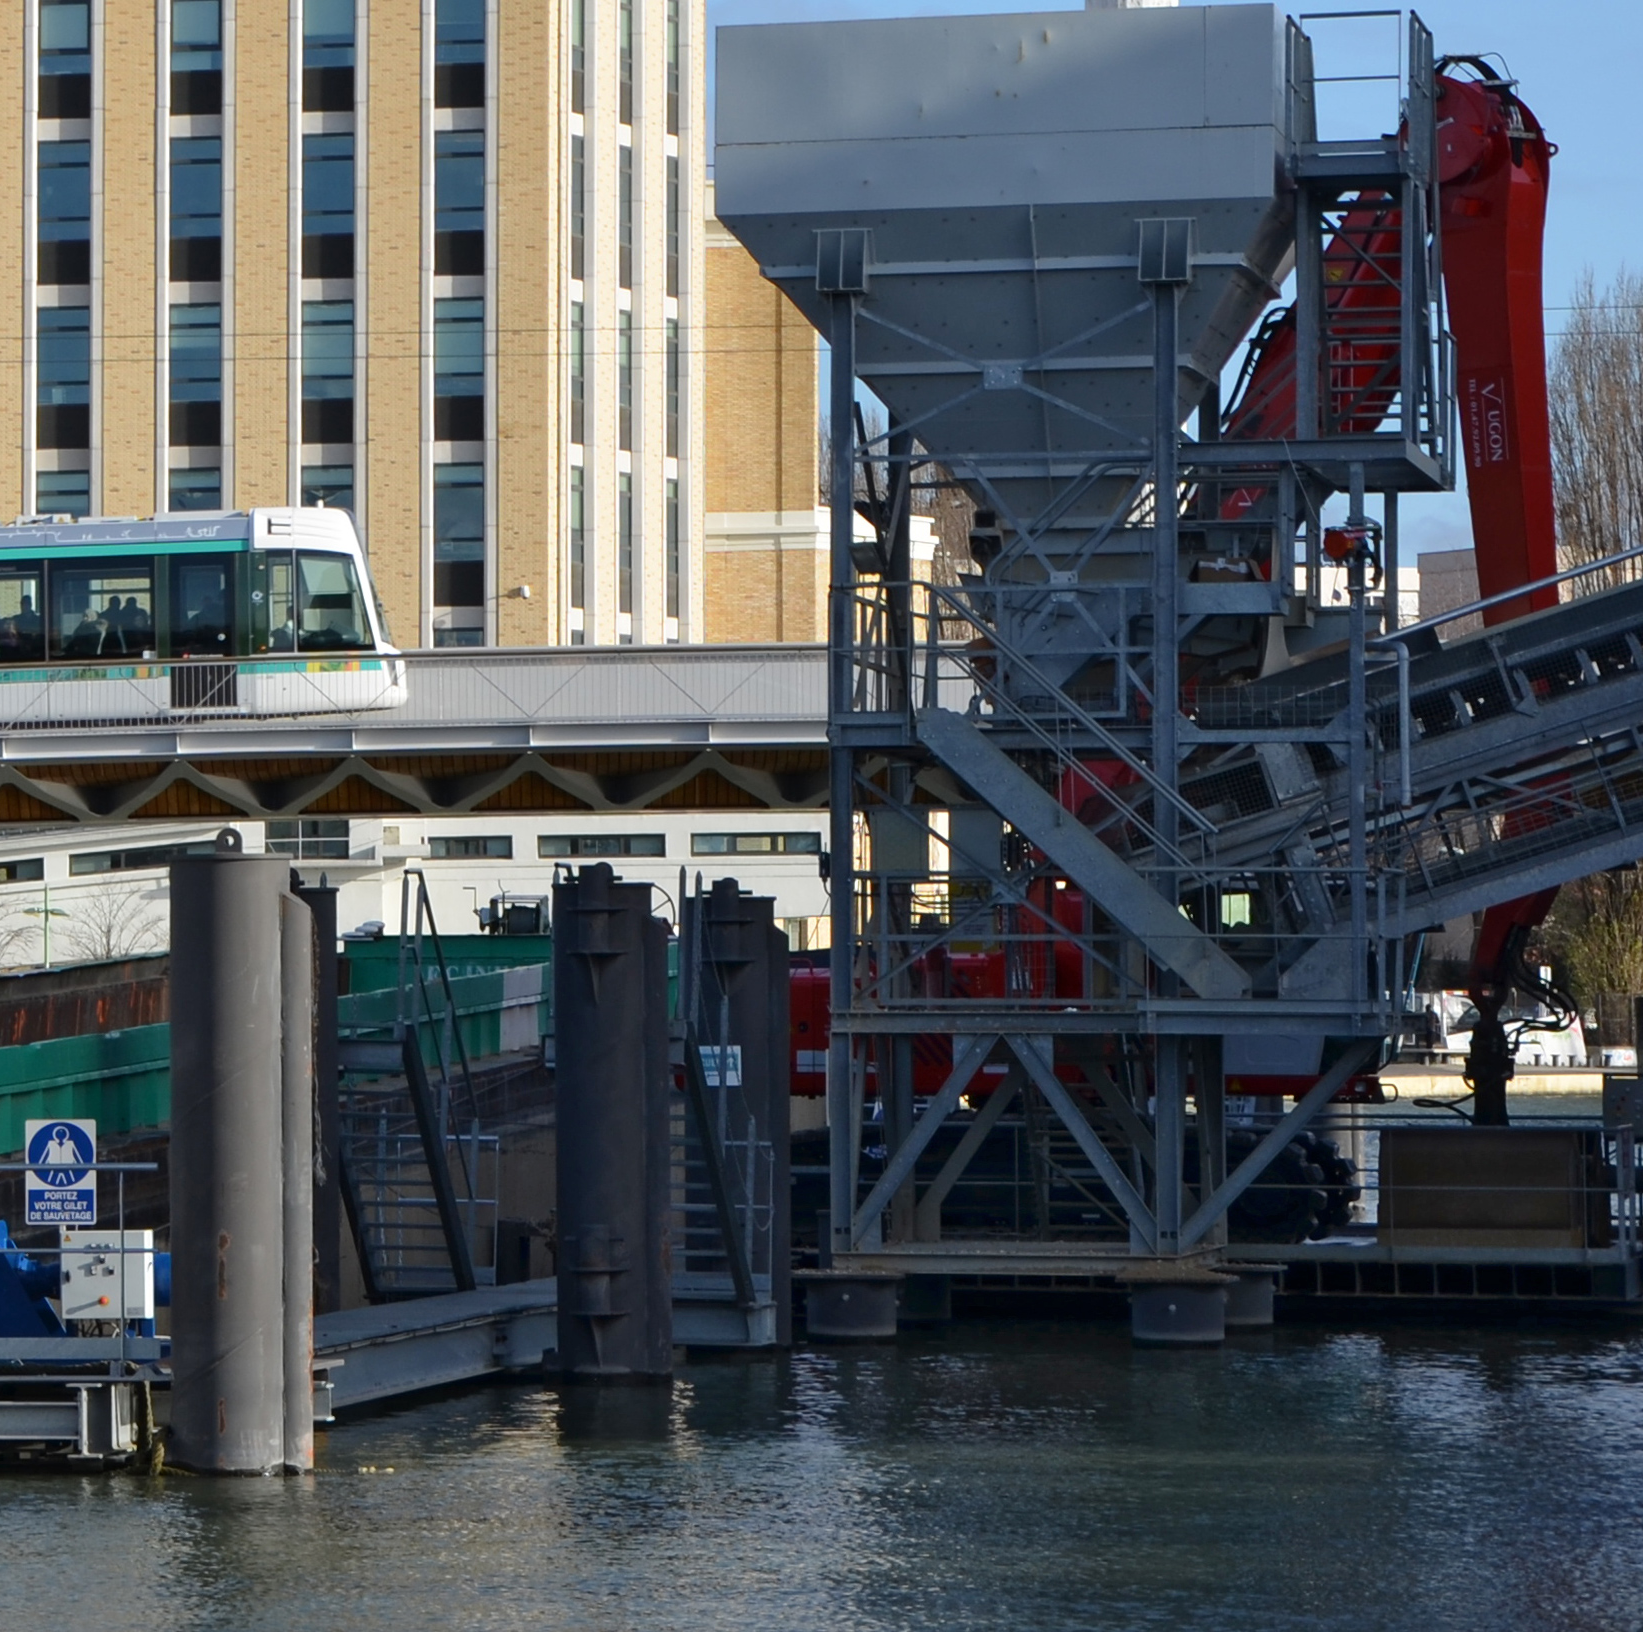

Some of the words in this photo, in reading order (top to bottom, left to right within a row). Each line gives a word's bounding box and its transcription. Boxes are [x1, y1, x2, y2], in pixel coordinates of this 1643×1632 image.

[44, 1191, 77, 1200] PORTEZ
[34, 1201, 62, 1210] VOTRE
[63, 1201, 87, 1210] GILET
[30, 1211, 42, 1220] DE
[43, 1211, 91, 1220] SAUVETAGE
